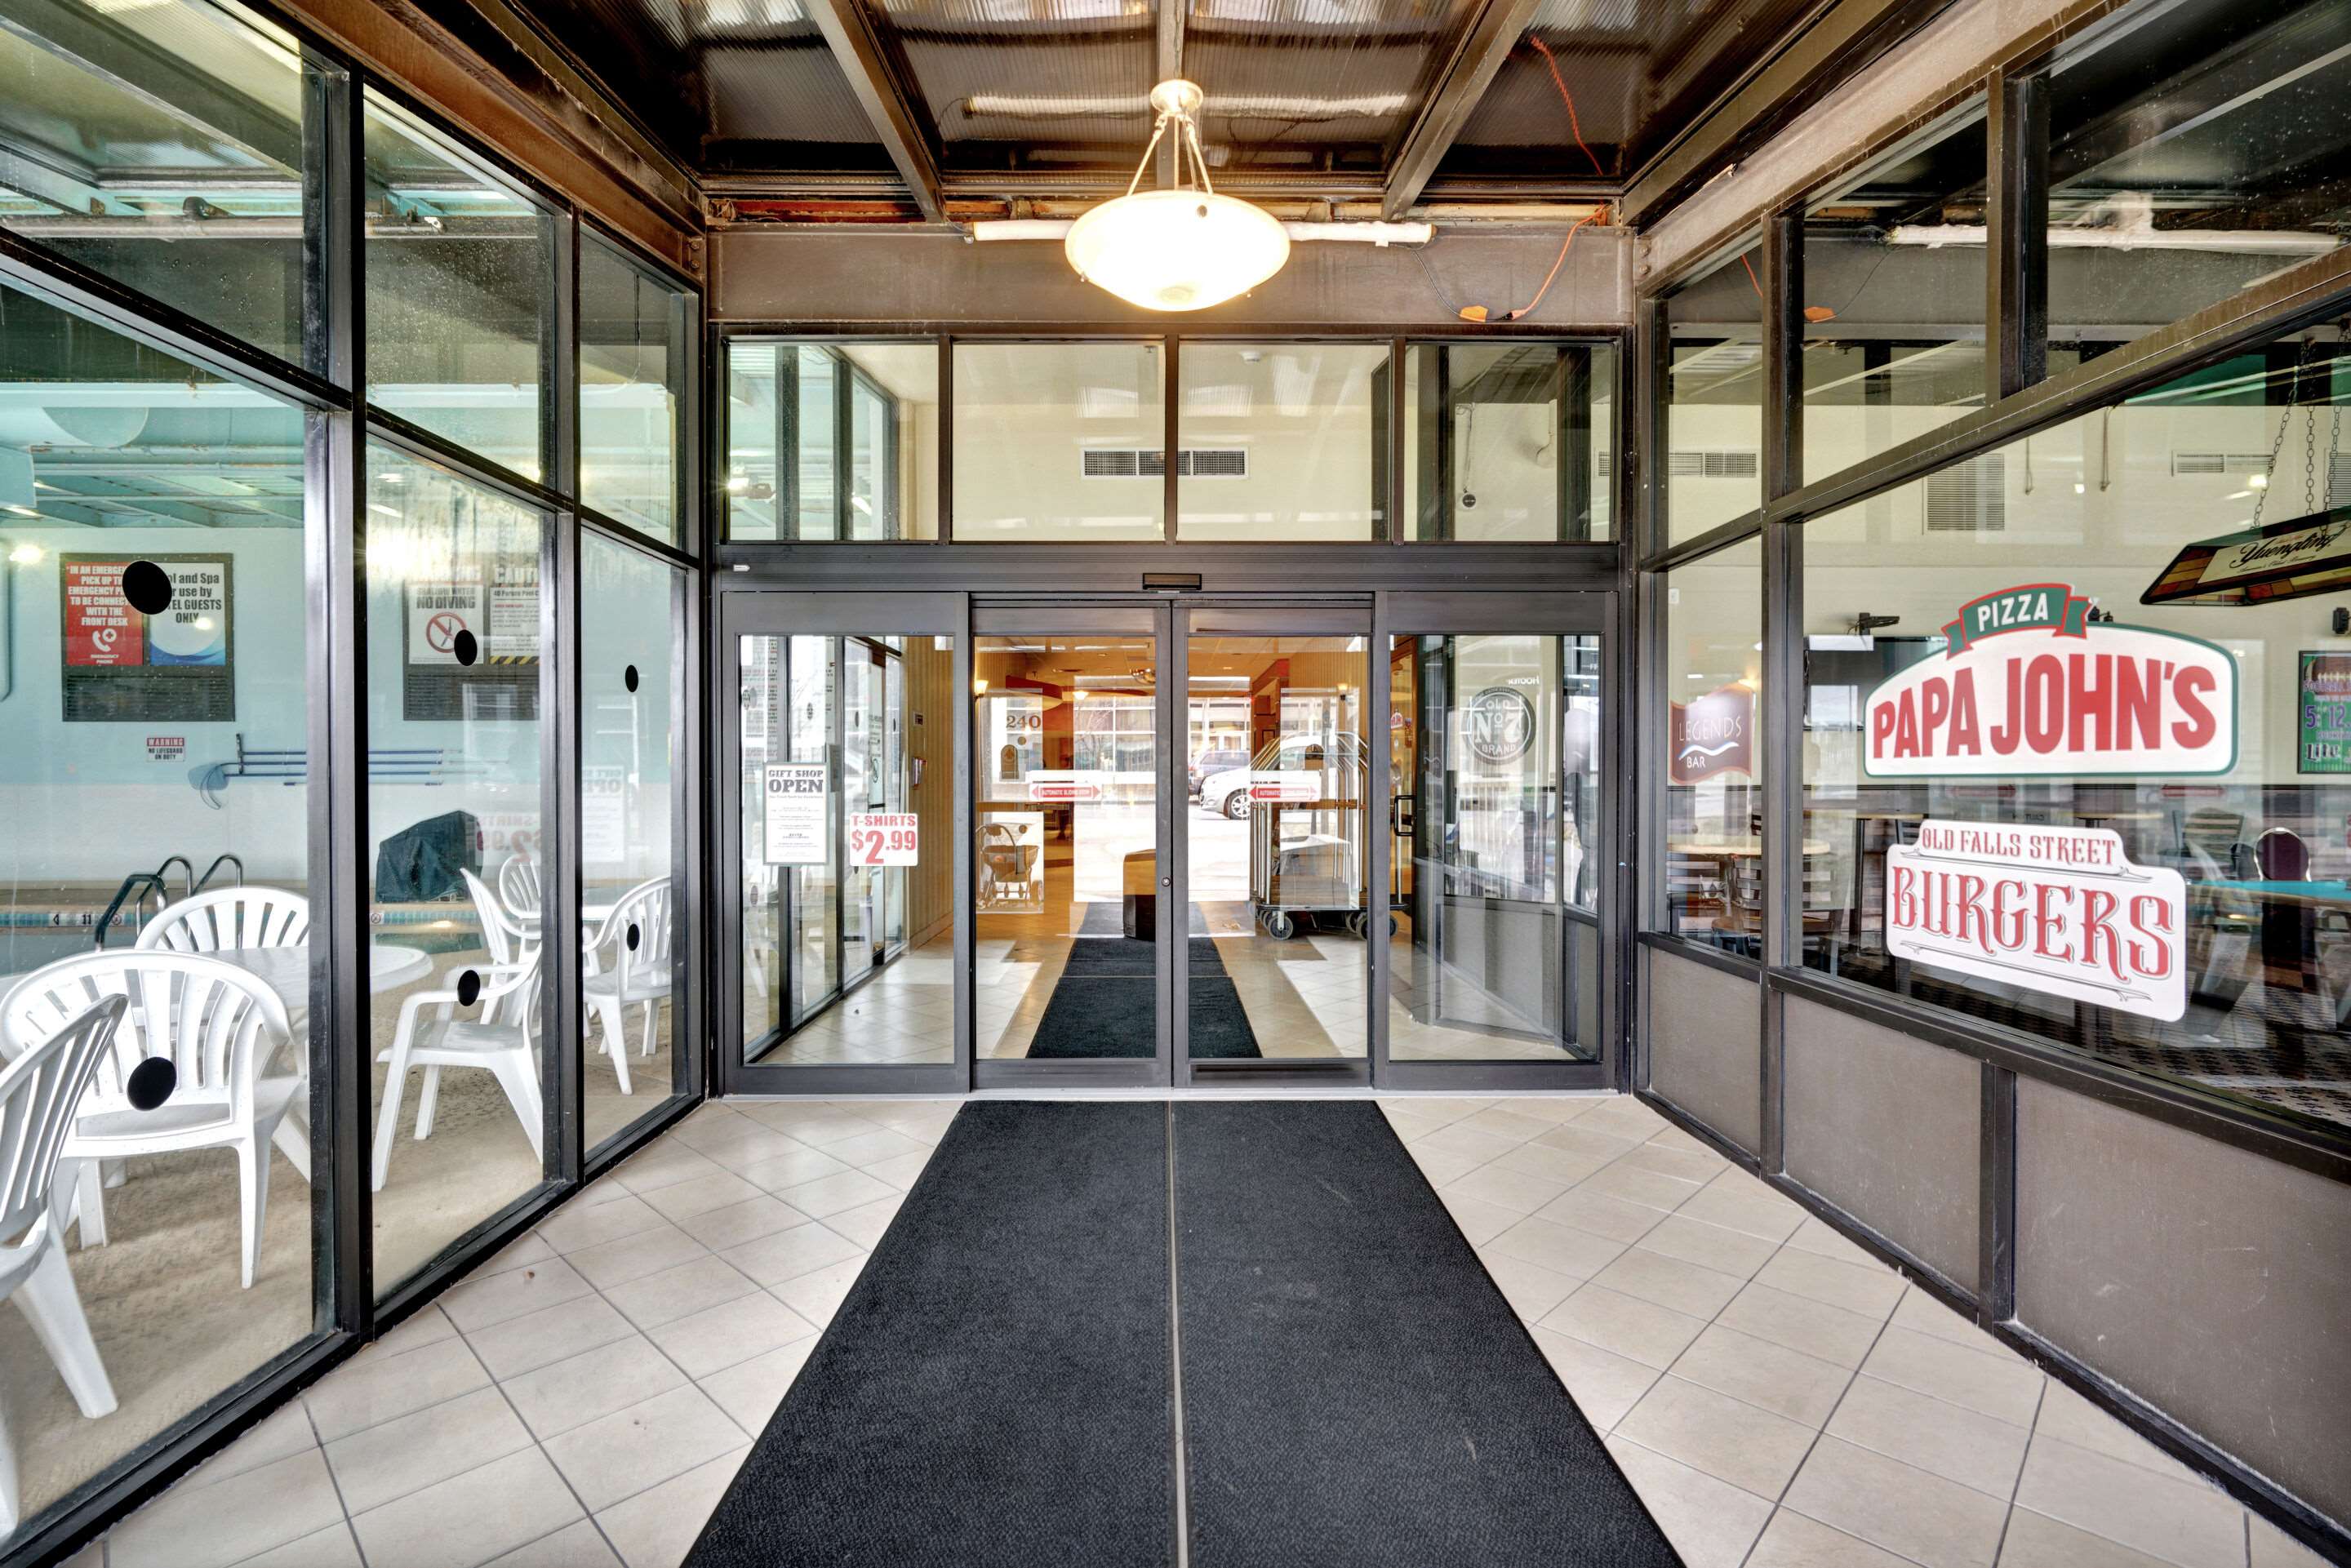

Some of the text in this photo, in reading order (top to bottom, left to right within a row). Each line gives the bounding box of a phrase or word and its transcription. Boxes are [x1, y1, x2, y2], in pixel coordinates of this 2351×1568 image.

[2229, 526, 2340, 568] Yuengling
[91, 565, 127, 575] EMERGE
[179, 573, 198, 584] and
[200, 573, 220, 584] Spa
[179, 587, 197, 597] use
[200, 586, 212, 597] by
[184, 599, 222, 610] GUESTS
[416, 596, 476, 609] NO DIVING
[176, 612, 199, 624] ONLY
[1977, 592, 2049, 632] PIZZA
[1486, 698, 1512, 710] OLD
[1873, 654, 2216, 758] PAPA JOHN'S
[1006, 715, 1041, 728] 240
[1678, 716, 1742, 741] LEGENDS
[148, 738, 184, 746] WARNING
[1482, 744, 1516, 756] BRAND
[1687, 756, 1705, 769] BAR
[769, 779, 824, 793] OPEN
[851, 815, 916, 826] T-SHIRTS
[851, 829, 916, 864] $2.99
[1922, 828, 2117, 865] OLD FALLS STREET
[1892, 866, 2173, 982] BURGERS
